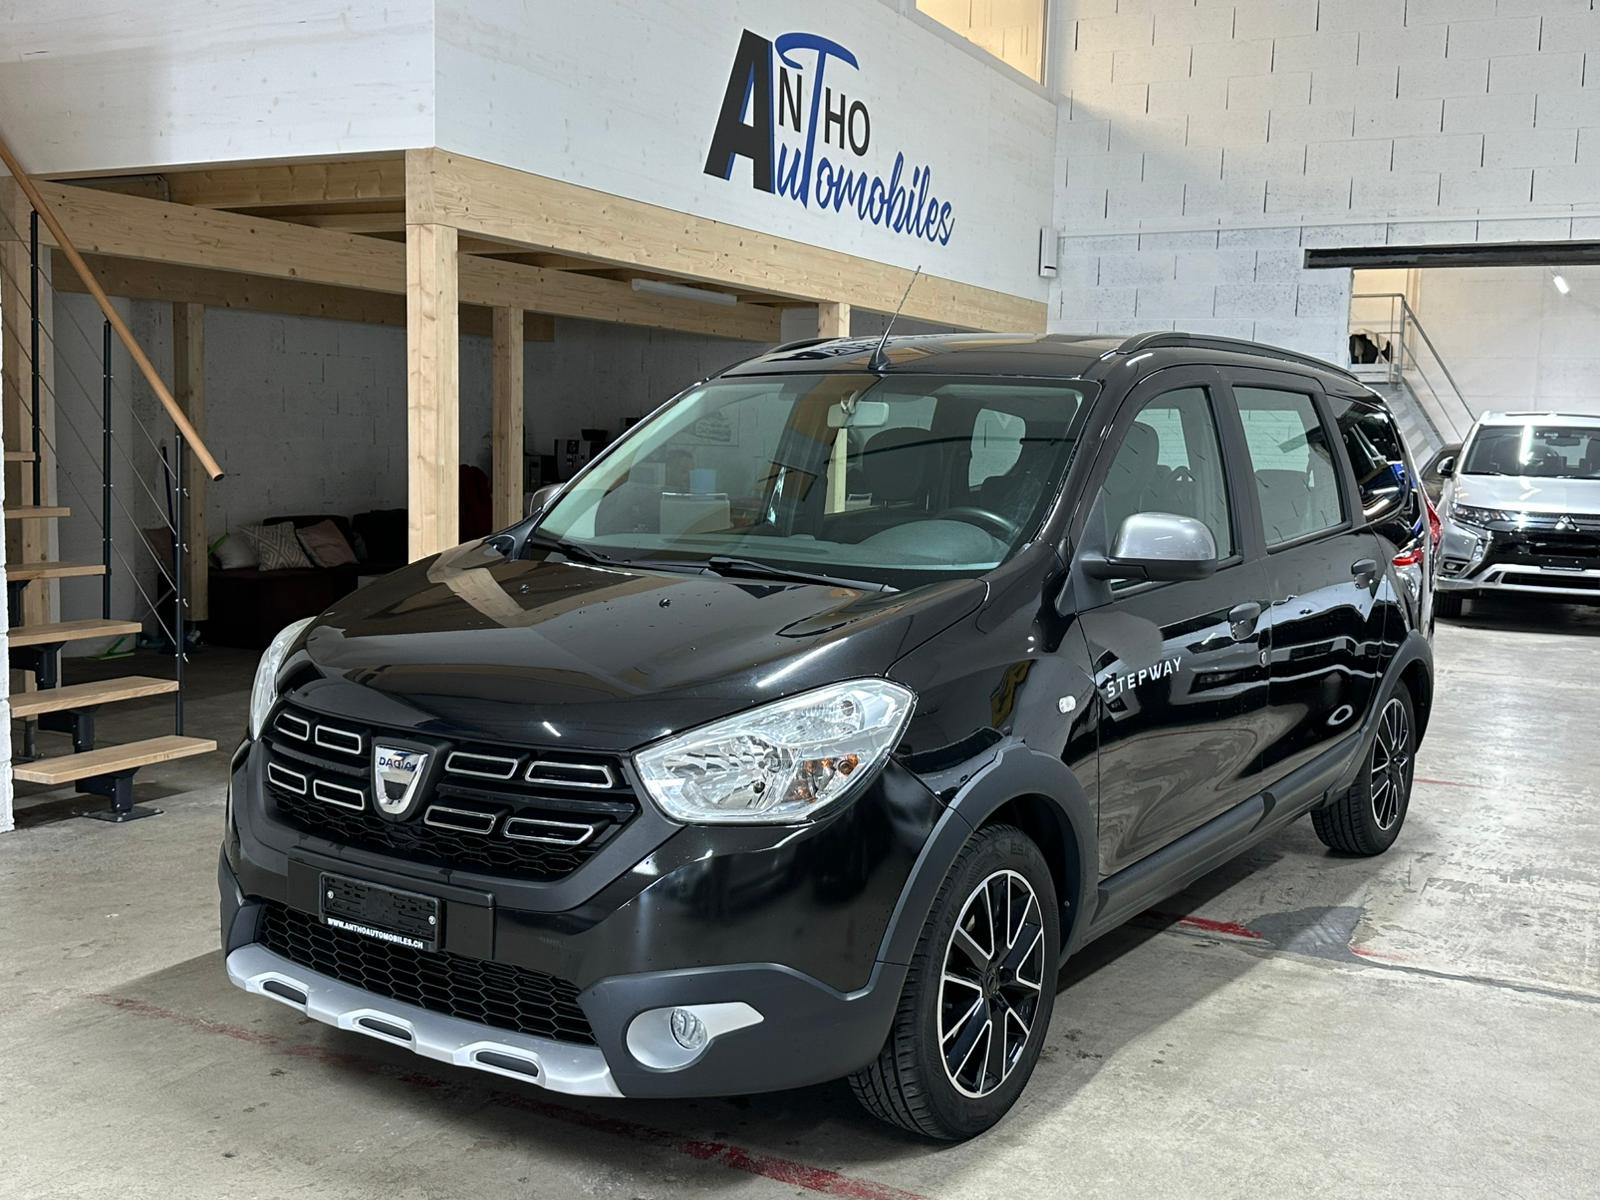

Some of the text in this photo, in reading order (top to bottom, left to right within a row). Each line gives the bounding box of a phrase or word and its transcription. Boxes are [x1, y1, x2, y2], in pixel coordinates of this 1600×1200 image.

[1106, 656, 1182, 698] STEPWAY
[379, 756, 412, 770] DACIA
[327, 917, 423, 949] WWW.ANTHOAUTOMOBILES.CH
